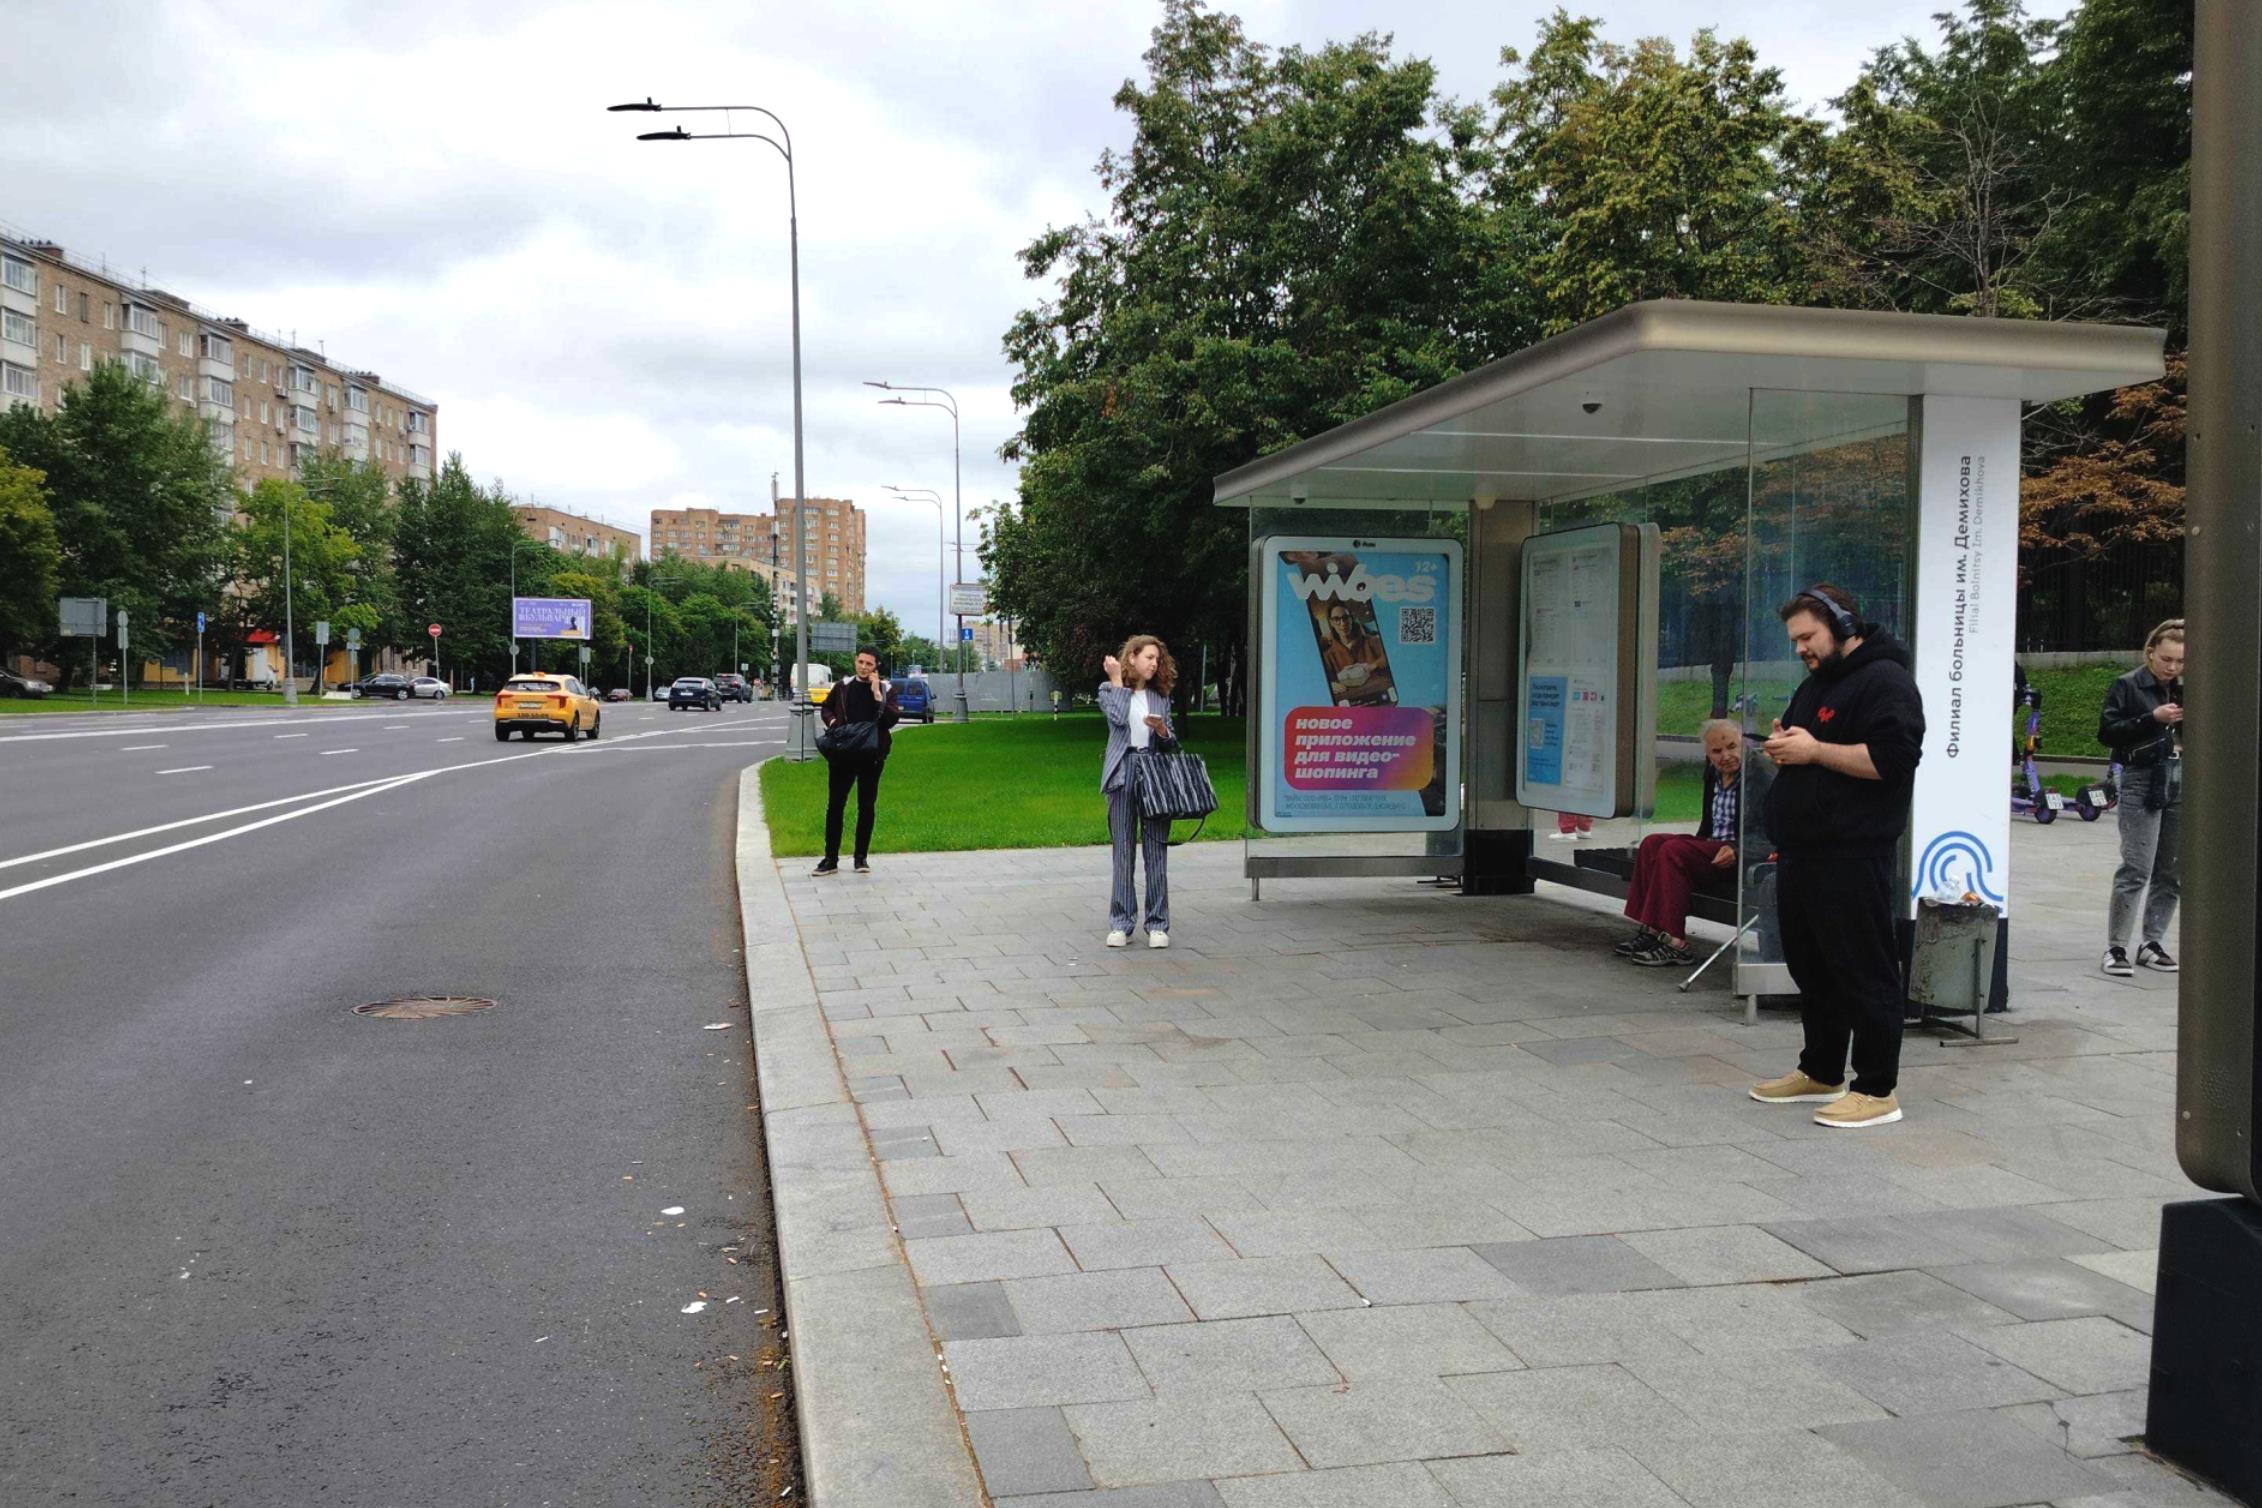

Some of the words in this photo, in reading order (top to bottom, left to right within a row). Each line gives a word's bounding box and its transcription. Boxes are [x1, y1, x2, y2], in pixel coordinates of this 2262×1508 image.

[1954, 456, 1971, 549] Демихова
[1973, 456, 1985, 525] Demikhova
[1972, 528, 1982, 548] Im.
[1415, 561, 1438, 572] 12+
[1955, 554, 1968, 583] им.
[1970, 551, 1983, 601] Bolnitsy
[1968, 602, 1980, 634] Filial
[1949, 589, 1967, 682] больницы
[1295, 718, 1353, 729] новое
[1946, 687, 1962, 758] Филиал
[1295, 735, 1417, 750] приложение
[1294, 751, 1331, 765] для
[1334, 751, 1400, 765] видео-
[1295, 767, 1379, 779] шопинга
